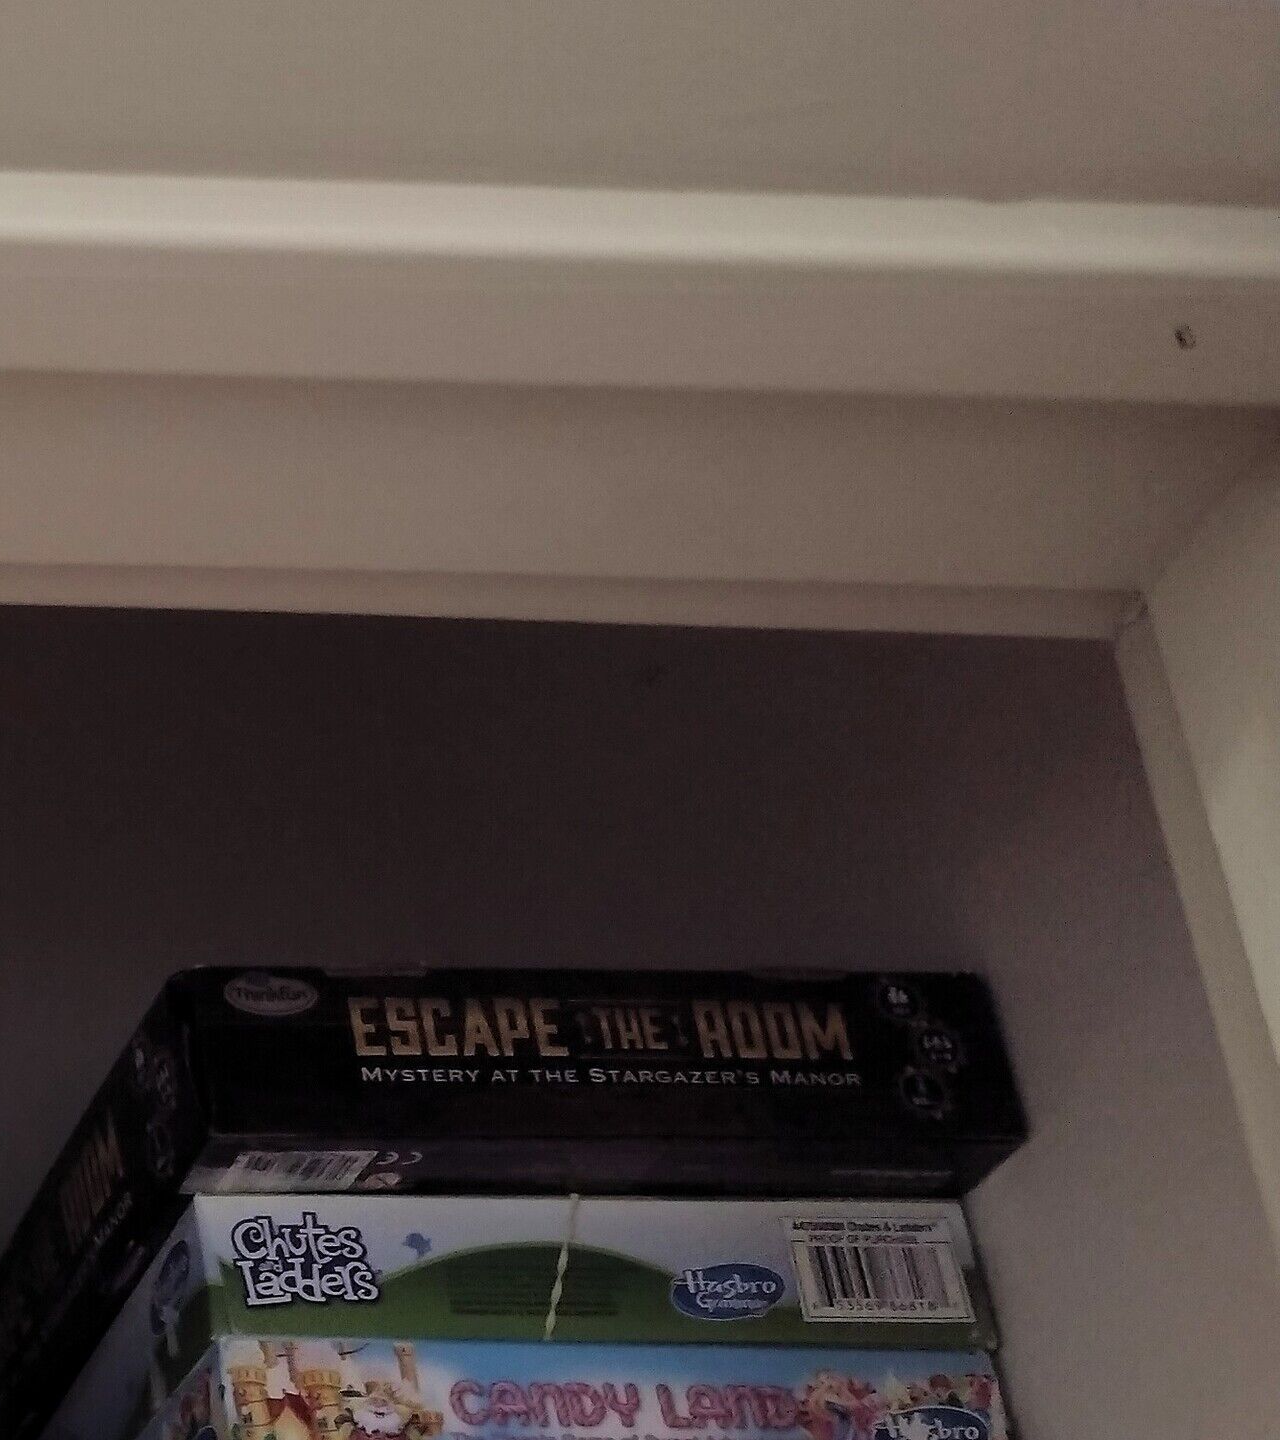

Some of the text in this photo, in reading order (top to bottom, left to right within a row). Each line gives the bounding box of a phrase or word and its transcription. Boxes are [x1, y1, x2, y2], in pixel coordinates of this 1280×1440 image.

[348, 998, 570, 1058] ESCAPE
[596, 1004, 669, 1051] THE
[691, 1001, 854, 1060] ROOM
[361, 1066, 863, 1087] MYSTERY AT THE STARGAZER'S MANOR
[231, 1213, 366, 1261] Chutes
[235, 1258, 379, 1306] Ladders
[673, 1268, 777, 1300] Hasbro
[450, 1380, 798, 1431] CANDY LAND
